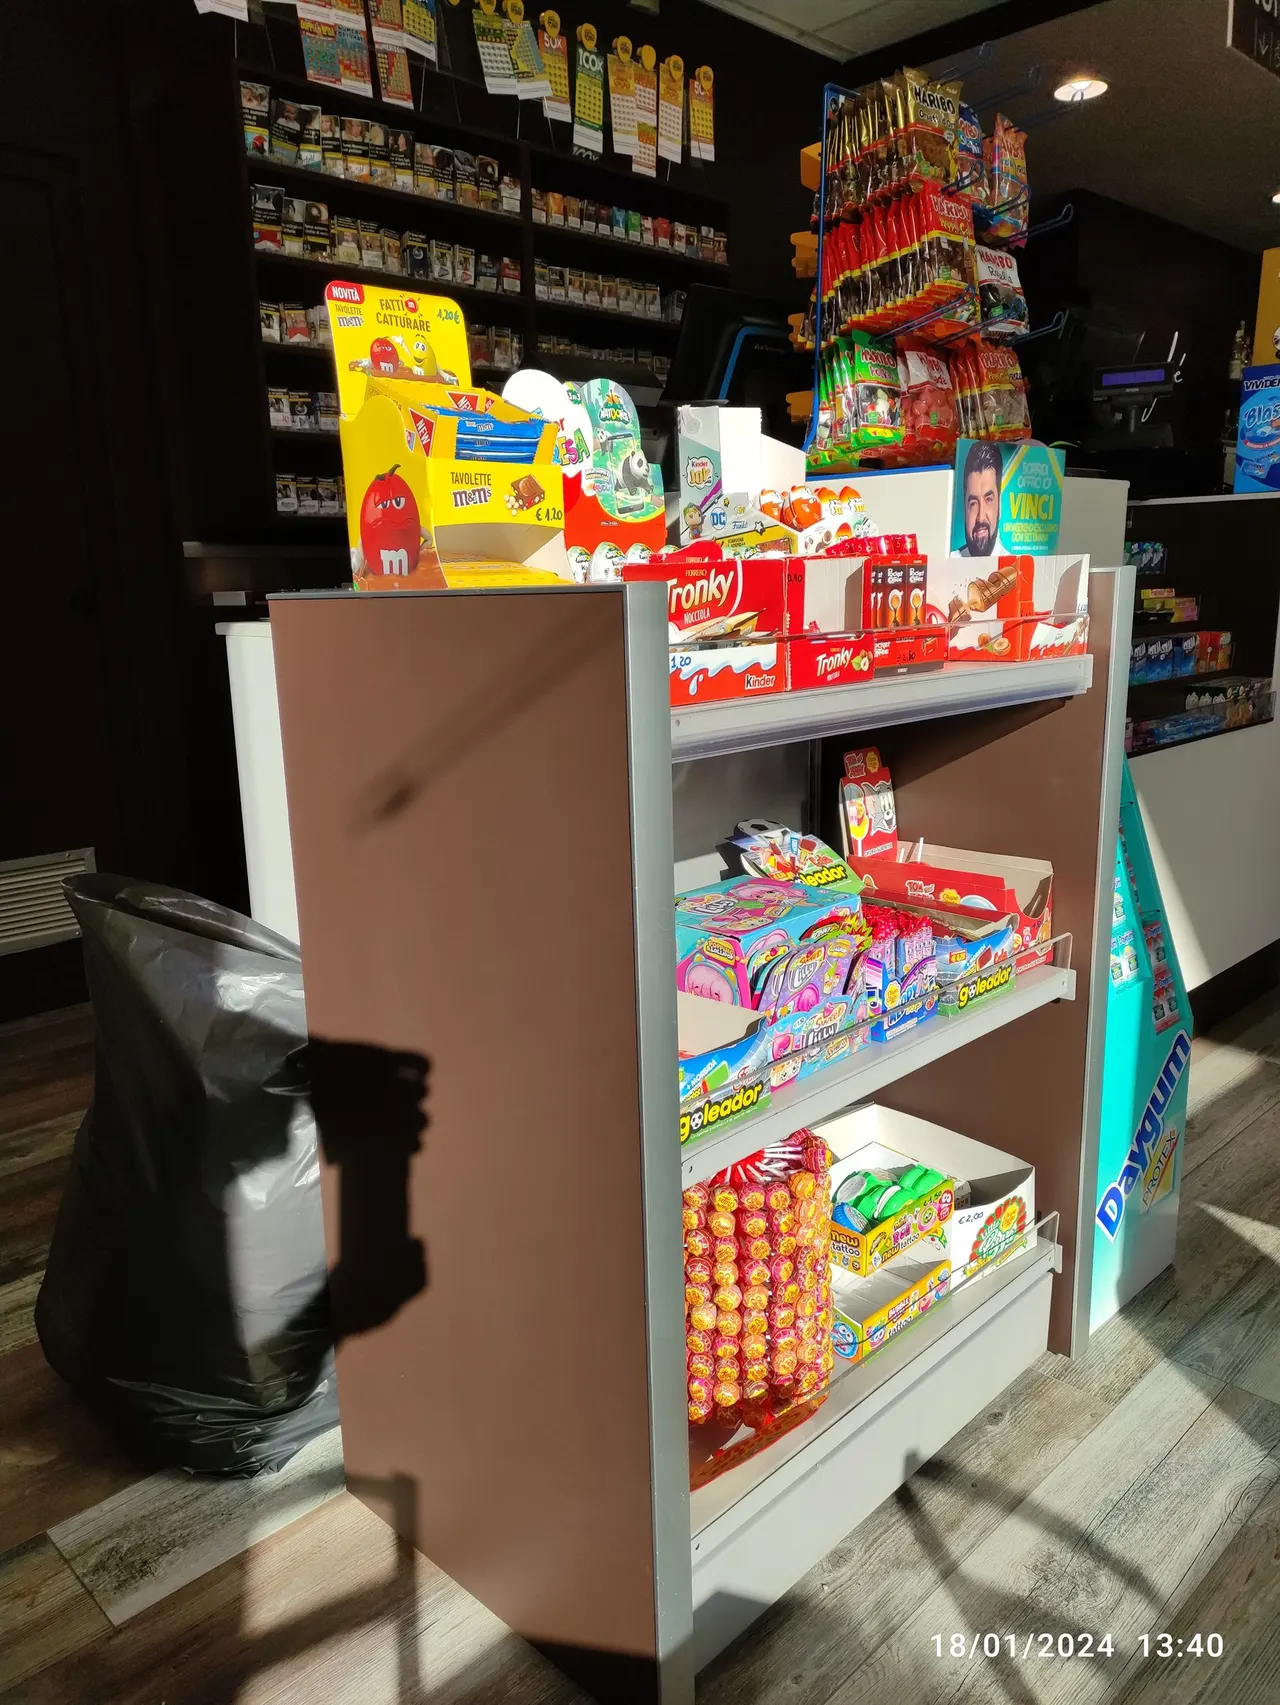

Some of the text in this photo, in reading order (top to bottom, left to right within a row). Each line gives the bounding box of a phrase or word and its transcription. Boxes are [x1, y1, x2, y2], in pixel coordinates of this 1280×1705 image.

[914, 85, 957, 116] HARIBO
[332, 286, 360, 302] NOVITÀ
[334, 304, 363, 316] TAVOLETTE
[379, 298, 404, 312] FATTI
[376, 312, 431, 333] CATTURARE
[1244, 402, 1280, 429] Blas
[416, 418, 431, 445] NEW
[450, 471, 492, 486] TAVOLETTE
[689, 467, 712, 485] JOY
[1009, 492, 1055, 521] VINCI
[710, 512, 727, 526] DC
[685, 569, 708, 577] FERRERO
[909, 568, 925, 577] Pocket
[666, 568, 735, 613] Tronky
[684, 607, 711, 625] NOCCIOLA
[816, 646, 854, 677] Tronky
[798, 866, 848, 887] leador
[815, 1007, 843, 1026] Sweet
[679, 1084, 763, 1142] goleador
[1096, 1032, 1191, 1241] Daygum
[1142, 1132, 1176, 1206] PROTEX
[958, 1212, 984, 1225] € 2,00
[831, 1230, 859, 1248] new
[882, 1243, 900, 1263] new
[900, 1233, 920, 1249] tattoo
[832, 1242, 861, 1257] tattoo
